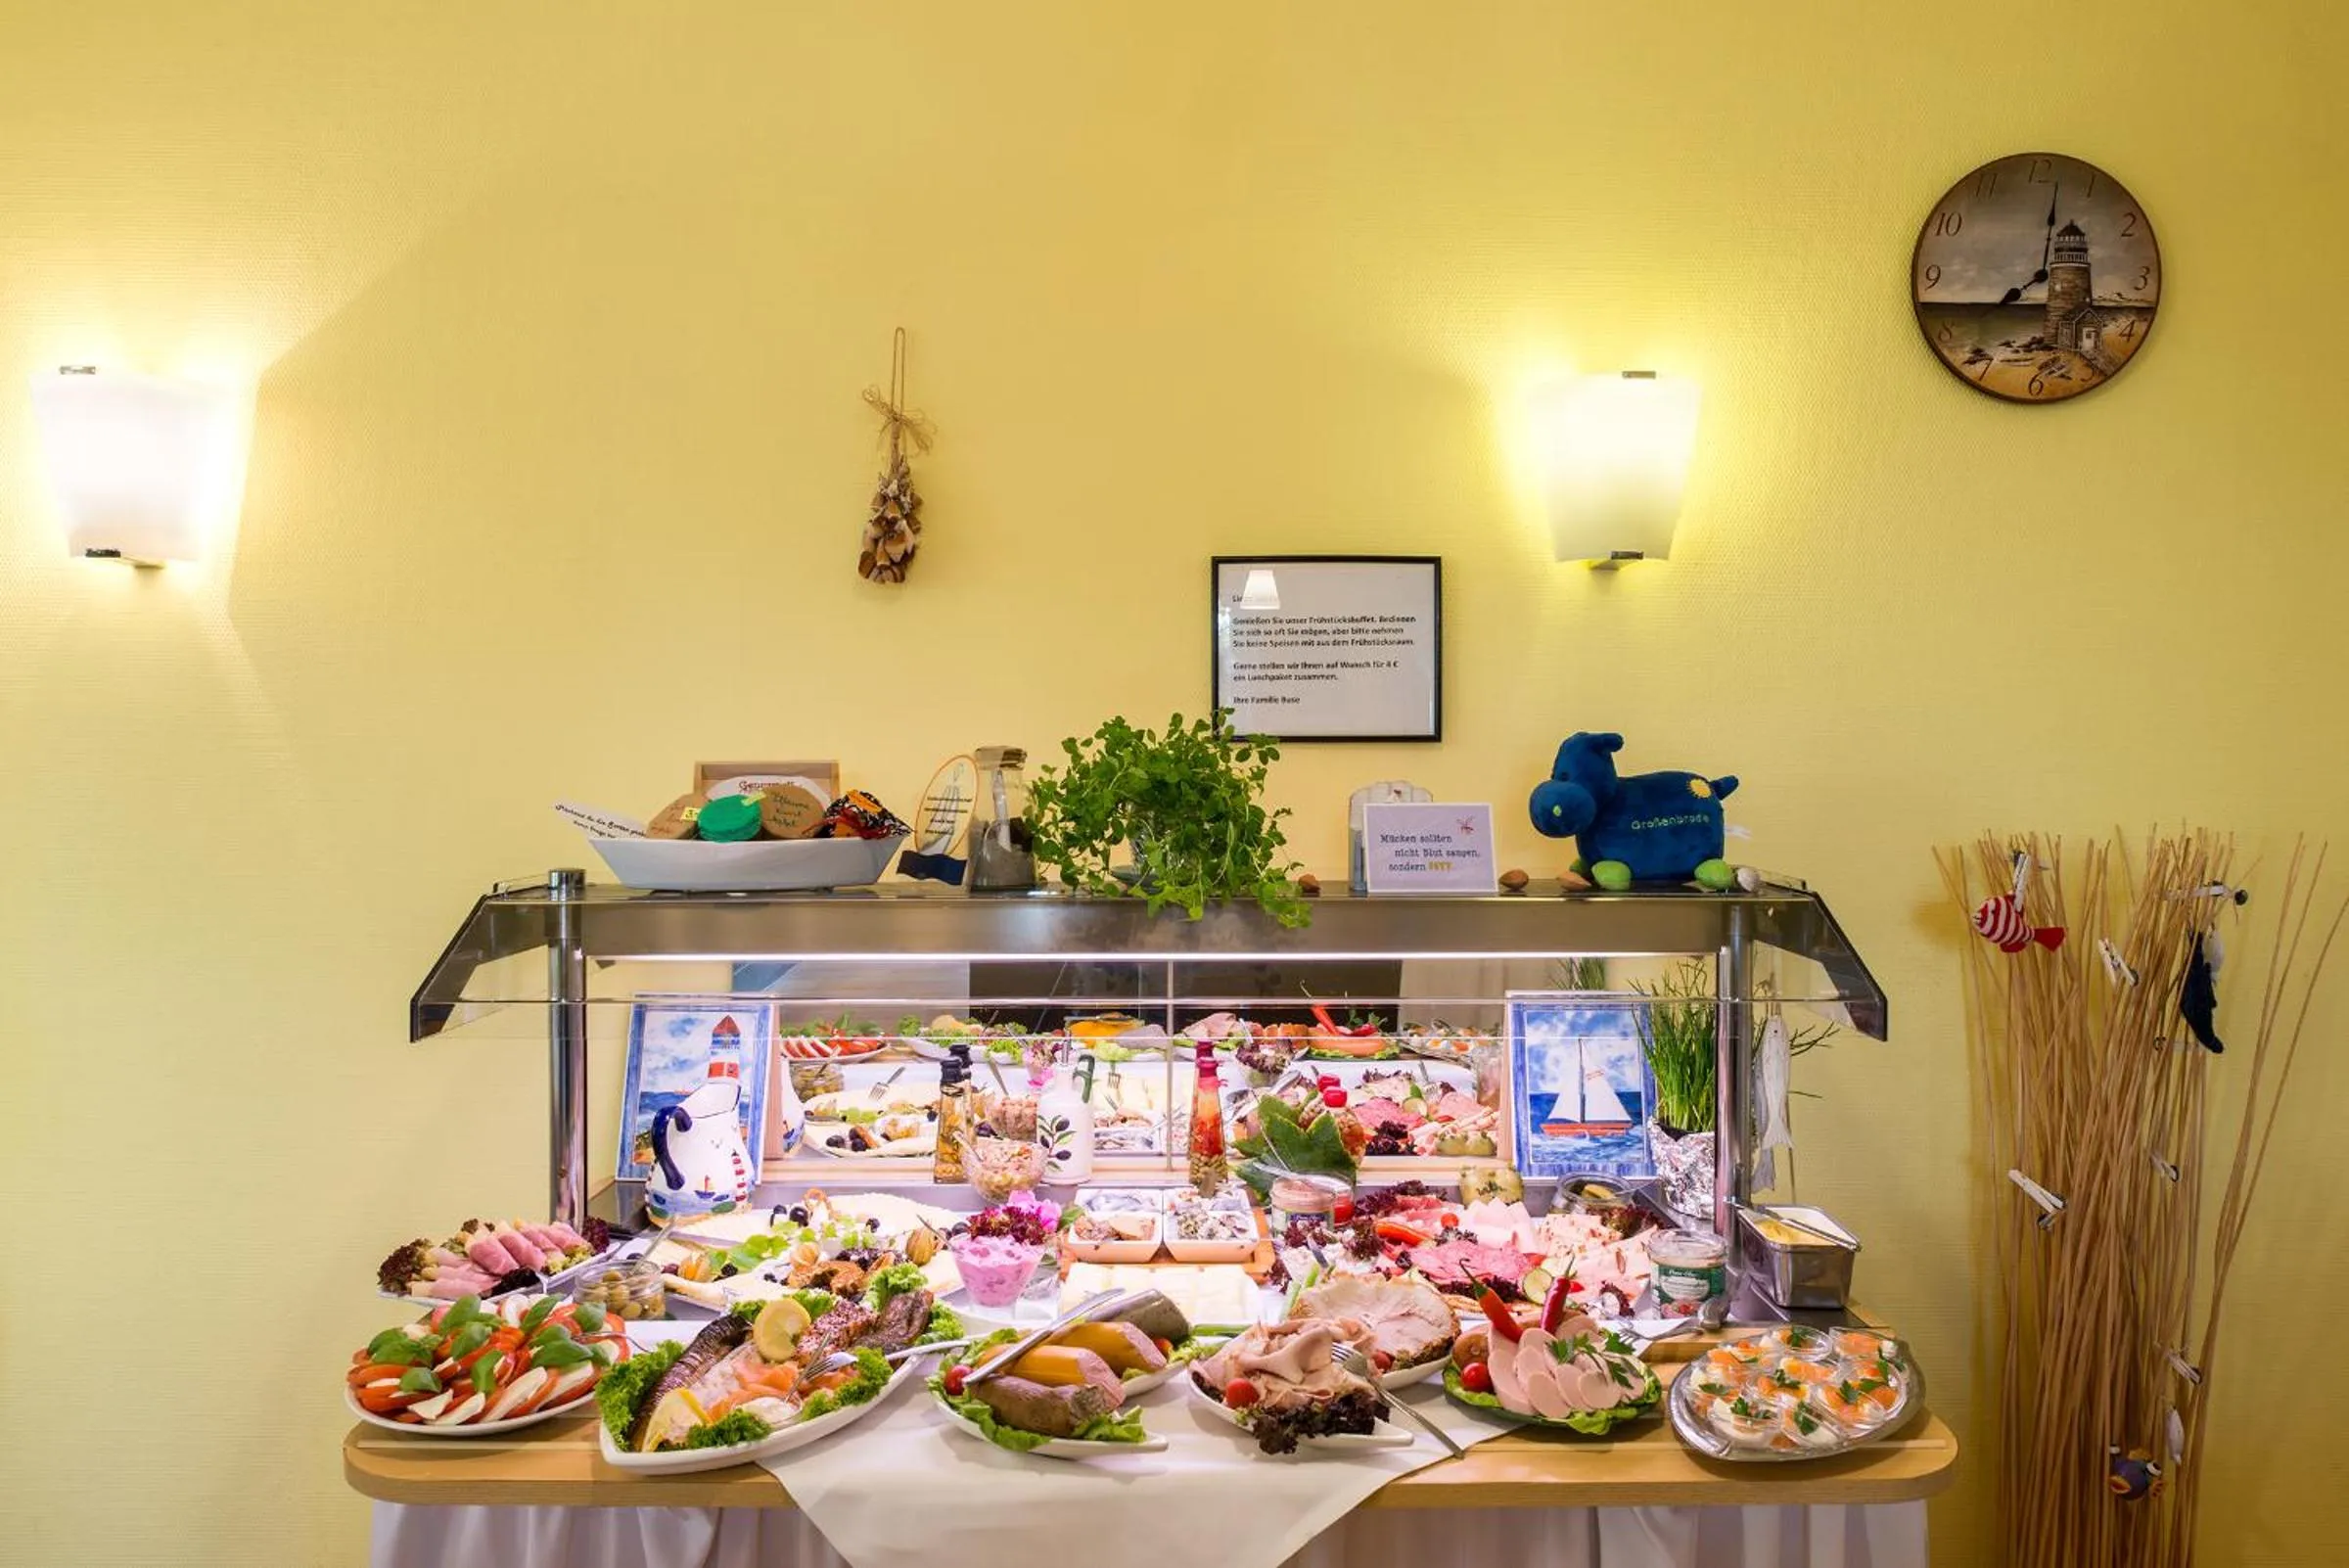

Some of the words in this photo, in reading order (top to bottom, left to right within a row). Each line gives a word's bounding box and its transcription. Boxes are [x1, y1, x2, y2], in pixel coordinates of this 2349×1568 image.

[2028, 158, 2052, 184] 12
[1975, 172, 1998, 197] 11
[1935, 211, 1962, 237] 10
[2121, 211, 2137, 238] 2
[1924, 264, 1941, 291] 9
[2134, 265, 2150, 291] 3
[1938, 318, 1956, 343] 8
[2119, 319, 2136, 343] 4
[1978, 357, 1994, 382] 7
[2028, 370, 2044, 396] 6
[1232, 616, 1270, 624] Genießen
[1232, 627, 1244, 636] Sie
[1246, 627, 1262, 636] sich
[1274, 627, 1286, 636] oft
[1287, 627, 1299, 636] Sie
[1332, 626, 1349, 635] aber
[1351, 626, 1370, 635] bitte
[1371, 626, 1404, 635] nehmen
[1232, 639, 1244, 648] Sie
[1246, 639, 1268, 648] keine
[1269, 639, 1300, 649] Speisen
[1233, 662, 1257, 670] Gerne
[1259, 662, 1285, 670] stellen
[1340, 661, 1371, 669] Wunsch
[1248, 672, 1293, 683] Lunchpaket
[1233, 696, 1249, 705] Ihre
[1251, 696, 1279, 705] Familie
[1631, 813, 1710, 830] Großenbrade
[1380, 834, 1416, 844] Mücken
[1420, 834, 1452, 843] sollten
[1395, 848, 1419, 857] nicht
[1423, 848, 1443, 857] Blut
[1388, 862, 1426, 872] sondern
